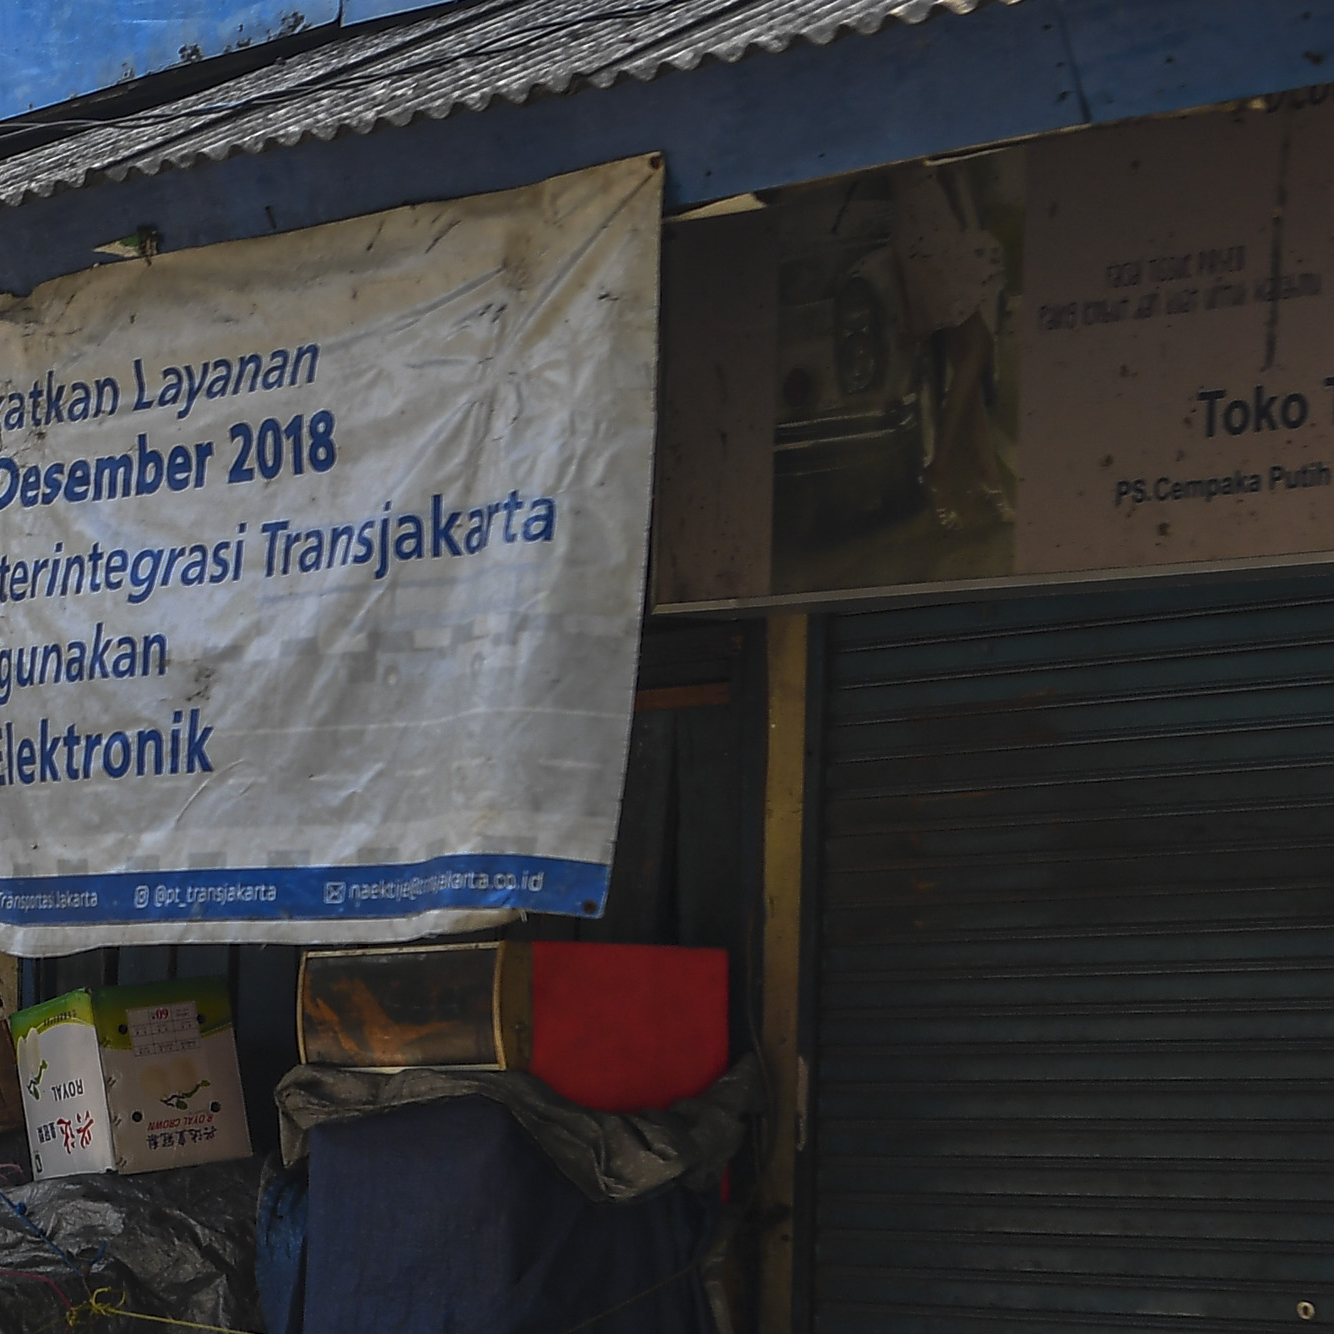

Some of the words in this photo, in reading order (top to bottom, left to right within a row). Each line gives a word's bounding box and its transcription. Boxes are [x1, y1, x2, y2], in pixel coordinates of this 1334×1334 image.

[133, 343, 321, 419] Layanan
[1197, 385, 1309, 438] Toko
[229, 409, 336, 484] 2018
[1270, 462, 1332, 490] Putih
[262, 489, 556, 580] Transjakarta
[51, 1078, 84, 1102] ROYAL
[147, 1118, 181, 1131] CROWN
